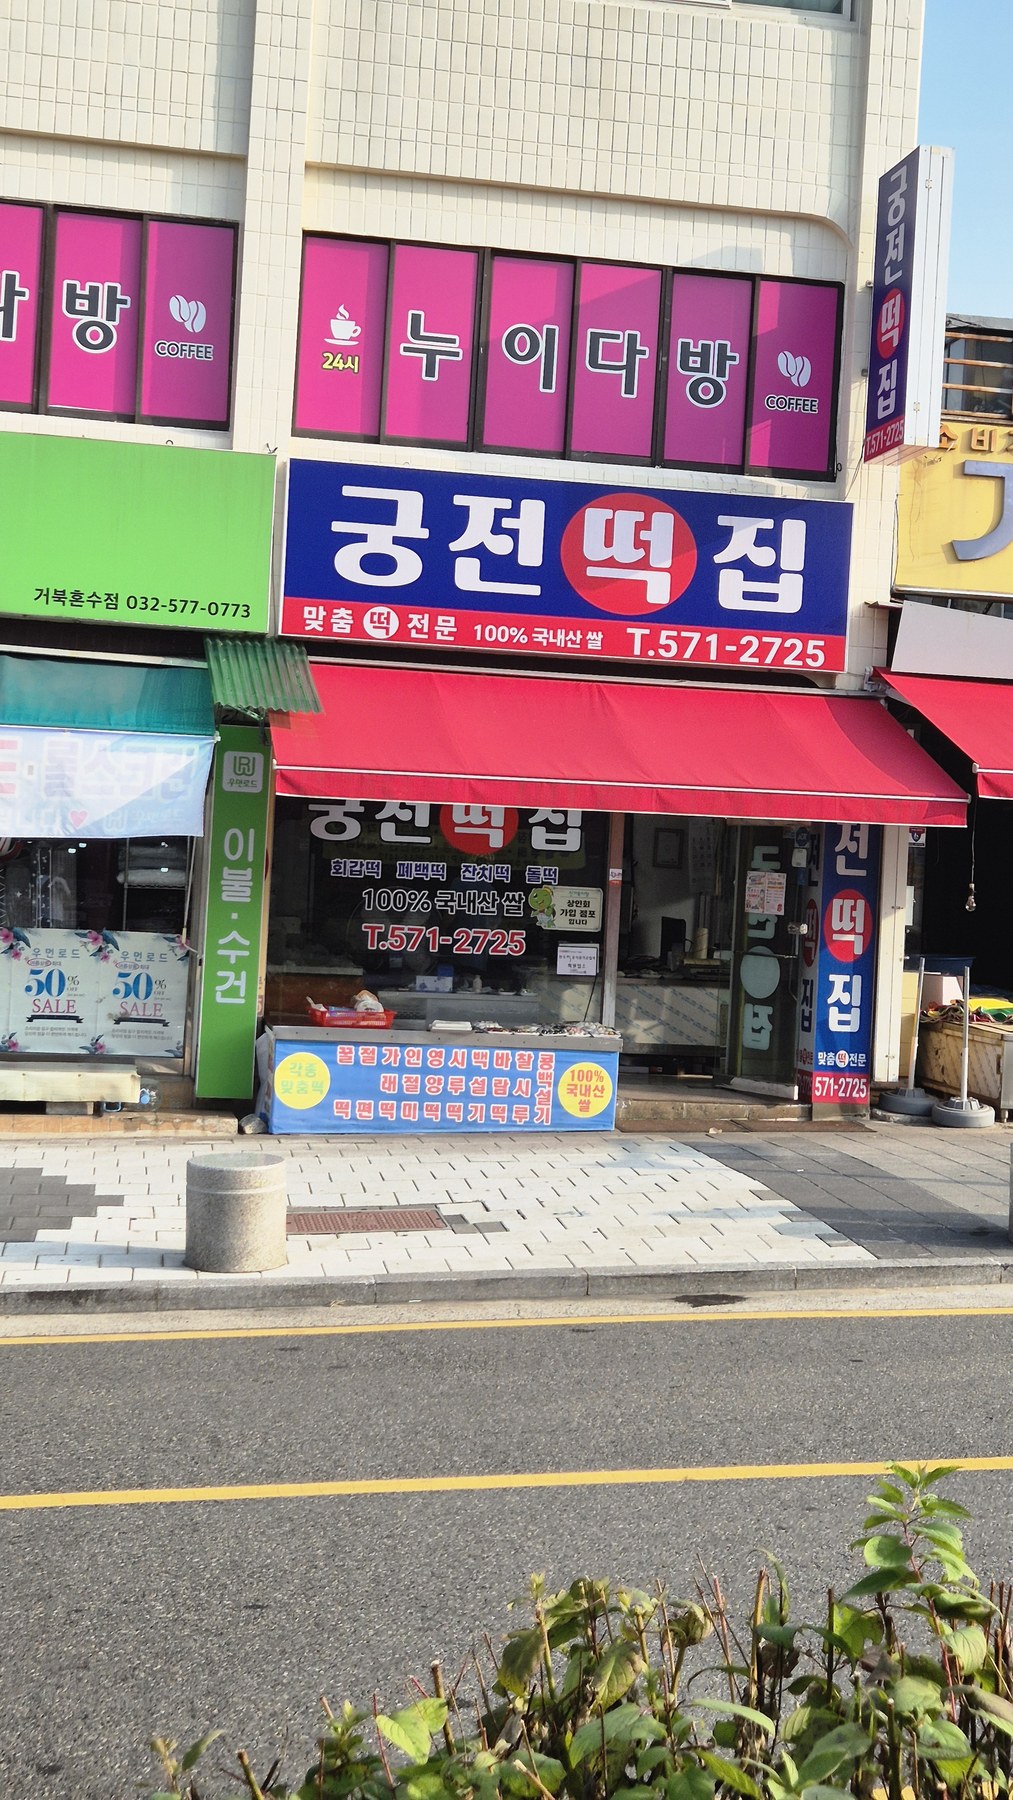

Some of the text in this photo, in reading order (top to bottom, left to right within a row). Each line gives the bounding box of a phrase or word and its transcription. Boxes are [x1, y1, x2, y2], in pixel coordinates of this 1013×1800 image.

[876, 164, 908, 420] 궁전떡집
[155, 341, 214, 361] COFFEE
[319, 351, 360, 373] 24시
[765, 395, 819, 414] COFFEE
[865, 419, 905, 460] T.571-2725
[939, 422, 1013, 453] 소비
[34, 587, 251, 619] 거북혼수점 032-577-0773
[474, 624, 528, 644] 100%
[531, 628, 583, 650] 국내산
[585, 631, 603, 651] 쌀
[626, 627, 825, 667] T.571-2725
[330, 858, 559, 886] 회갑떡 폐백떡 잔치떡 돌떡
[362, 888, 527, 918] 100% 국내산 쌀
[560, 909, 577, 917] 가입
[568, 918, 588, 926] 입니다
[361, 924, 527, 957] T.571-2725
[32, 998, 77, 1014] SALE
[120, 1001, 163, 1018] SALE
[289, 1062, 317, 1077] 각종
[570, 1069, 605, 1083] 100%
[566, 1083, 606, 1098] 국내산
[814, 1076, 867, 1098] 571-2725
[578, 1099, 591, 1112] 쌀
